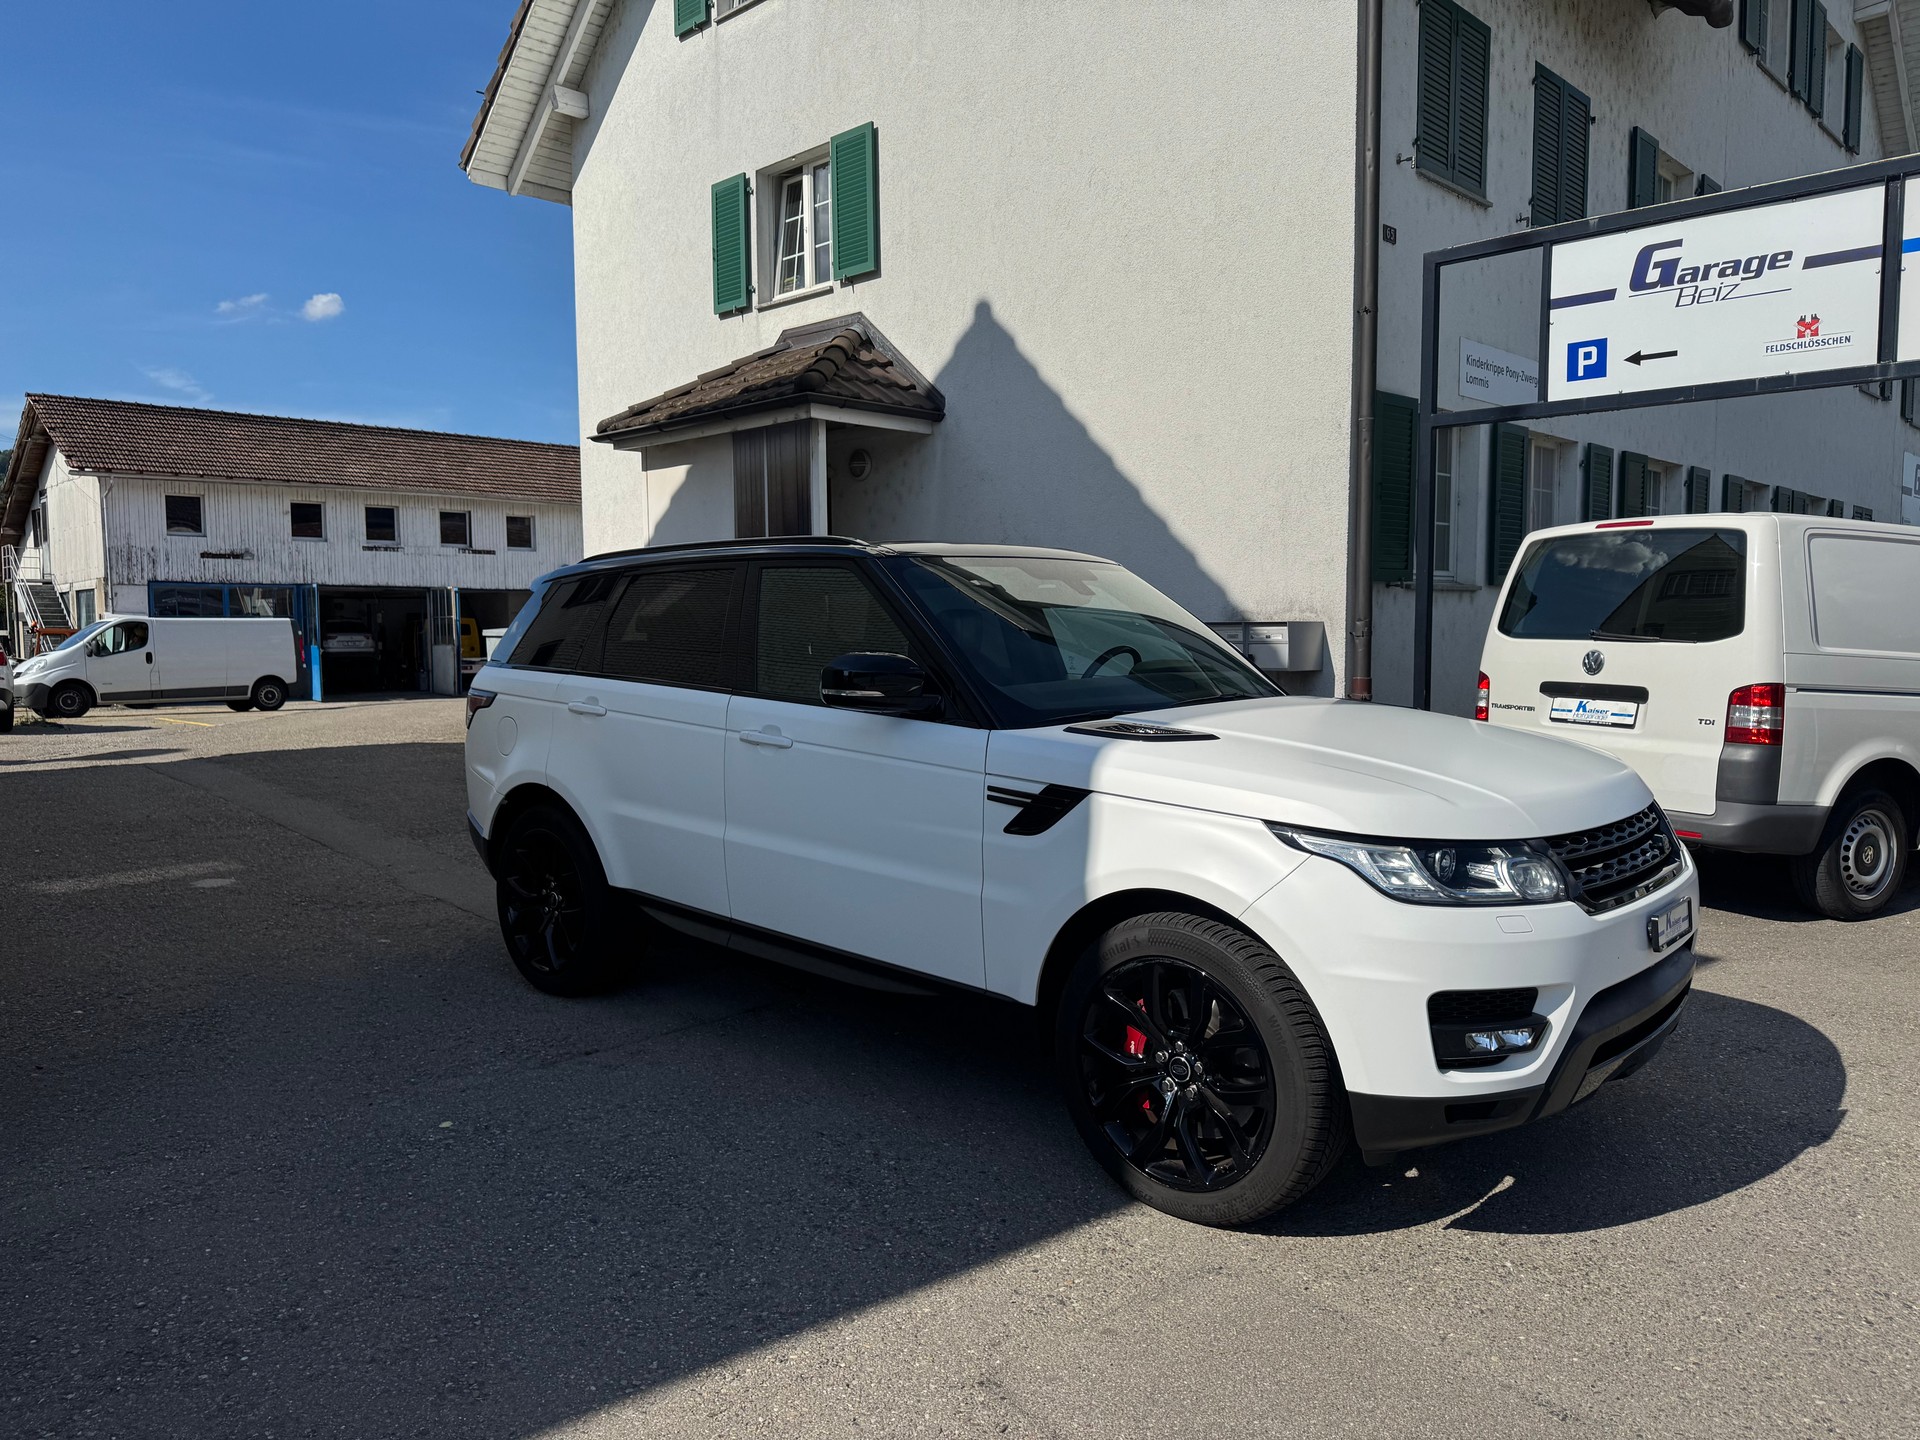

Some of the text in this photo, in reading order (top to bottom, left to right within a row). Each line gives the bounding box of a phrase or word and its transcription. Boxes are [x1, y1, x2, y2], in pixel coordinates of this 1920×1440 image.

[1629, 238, 1794, 292] Garage
[1675, 281, 1741, 308] Beiz
[1765, 335, 1852, 354] FELDSCHLÖSSCHEN
[1466, 353, 1505, 377] Kinderkrippe
[1577, 345, 1598, 377] P
[1465, 371, 1490, 389] Lommis
[1491, 702, 1536, 712] TRANSPORTER
[1575, 700, 1610, 715] Kaiser
[1698, 718, 1715, 726] TDI
